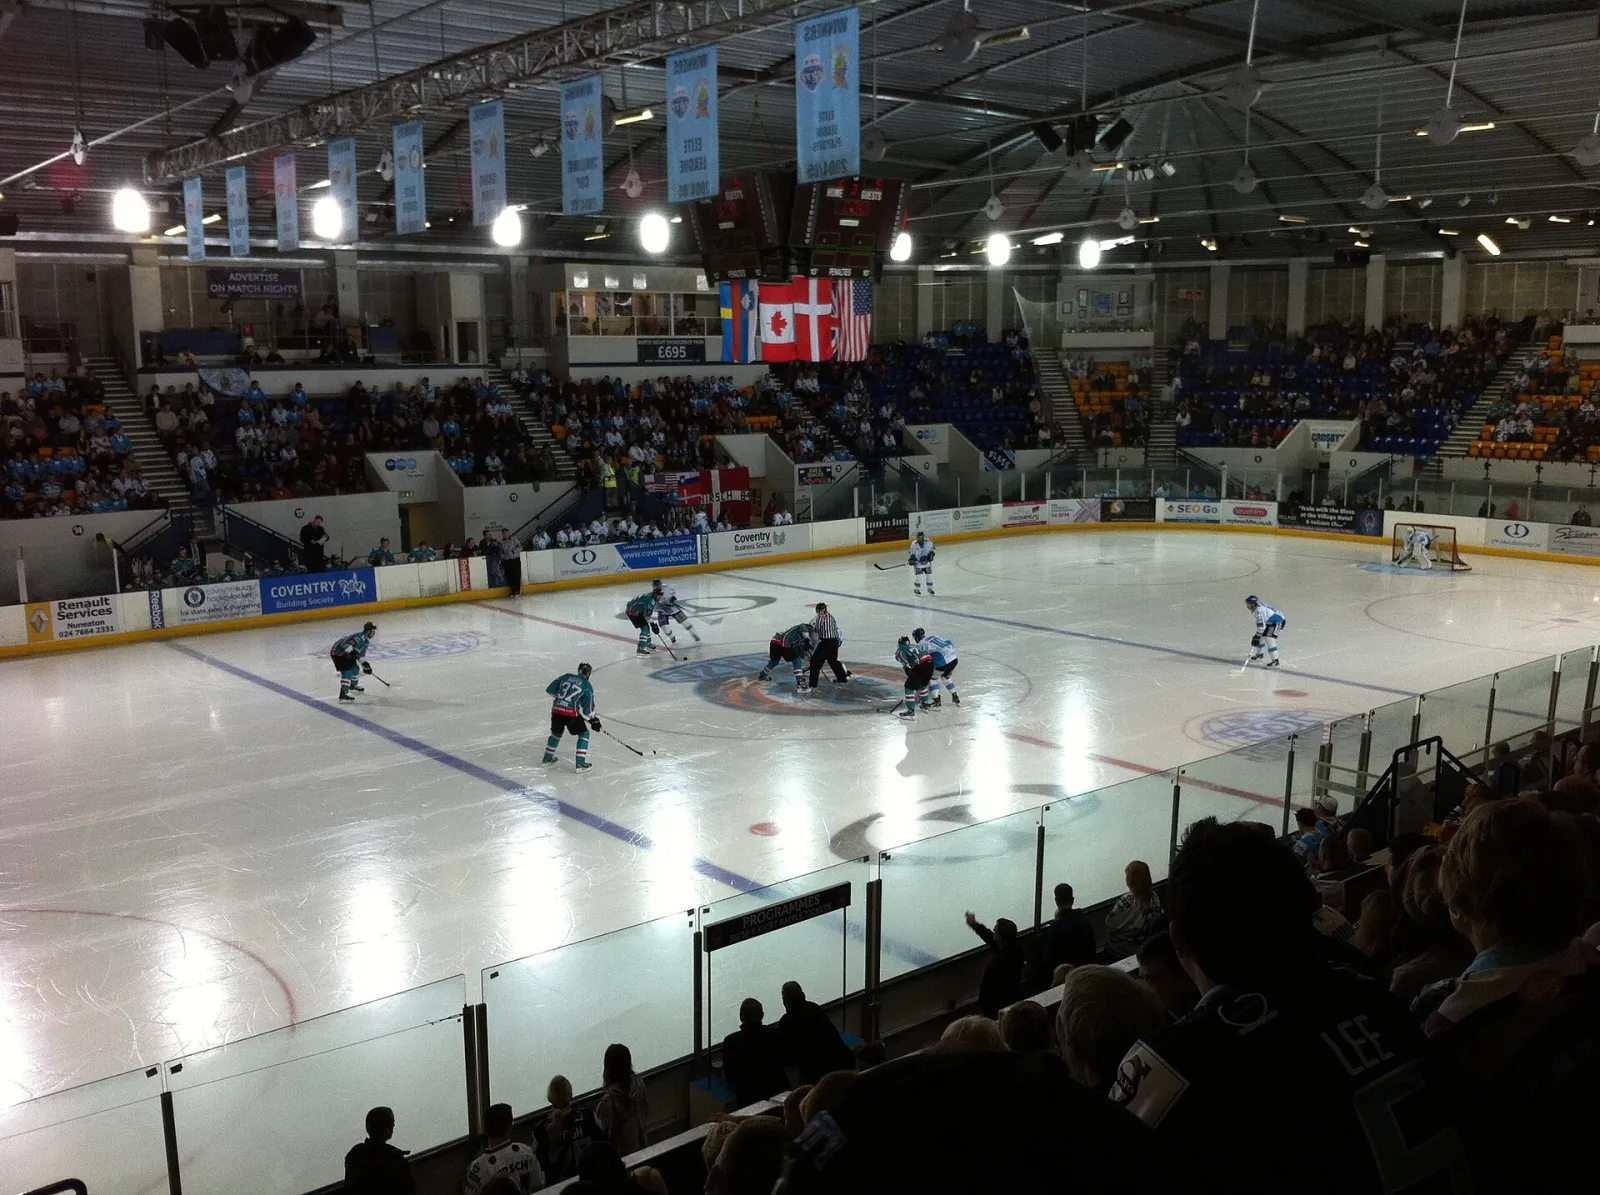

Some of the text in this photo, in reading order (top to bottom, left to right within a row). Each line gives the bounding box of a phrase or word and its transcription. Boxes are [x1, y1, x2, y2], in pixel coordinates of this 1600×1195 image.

[229, 273, 280, 282] ADVERTISE
[210, 284, 298, 294] ON MATCH NIGHTS
[657, 345, 687, 359] £695
[1177, 504, 1218, 514] SEO Go
[734, 532, 771, 545] Coventry
[622, 546, 696, 559] www.coventry.gov.uk/
[734, 542, 772, 552] Business School
[658, 553, 697, 564] london2012
[460, 560, 468, 590] Reebok
[270, 580, 336, 598] COVENTRY
[58, 597, 110, 611] Renault
[276, 596, 334, 609] Building Society
[57, 607, 113, 621] Services
[151, 590, 162, 629] Reebok
[67, 620, 105, 630] Nuneaton
[59, 626, 114, 638] 024 7664 2331
[558, 681, 583, 702] 37
[742, 894, 821, 929] PROGRAMMES
[804, 903, 832, 919] TICKETS
[1320, 1014, 1396, 1076] LEE
